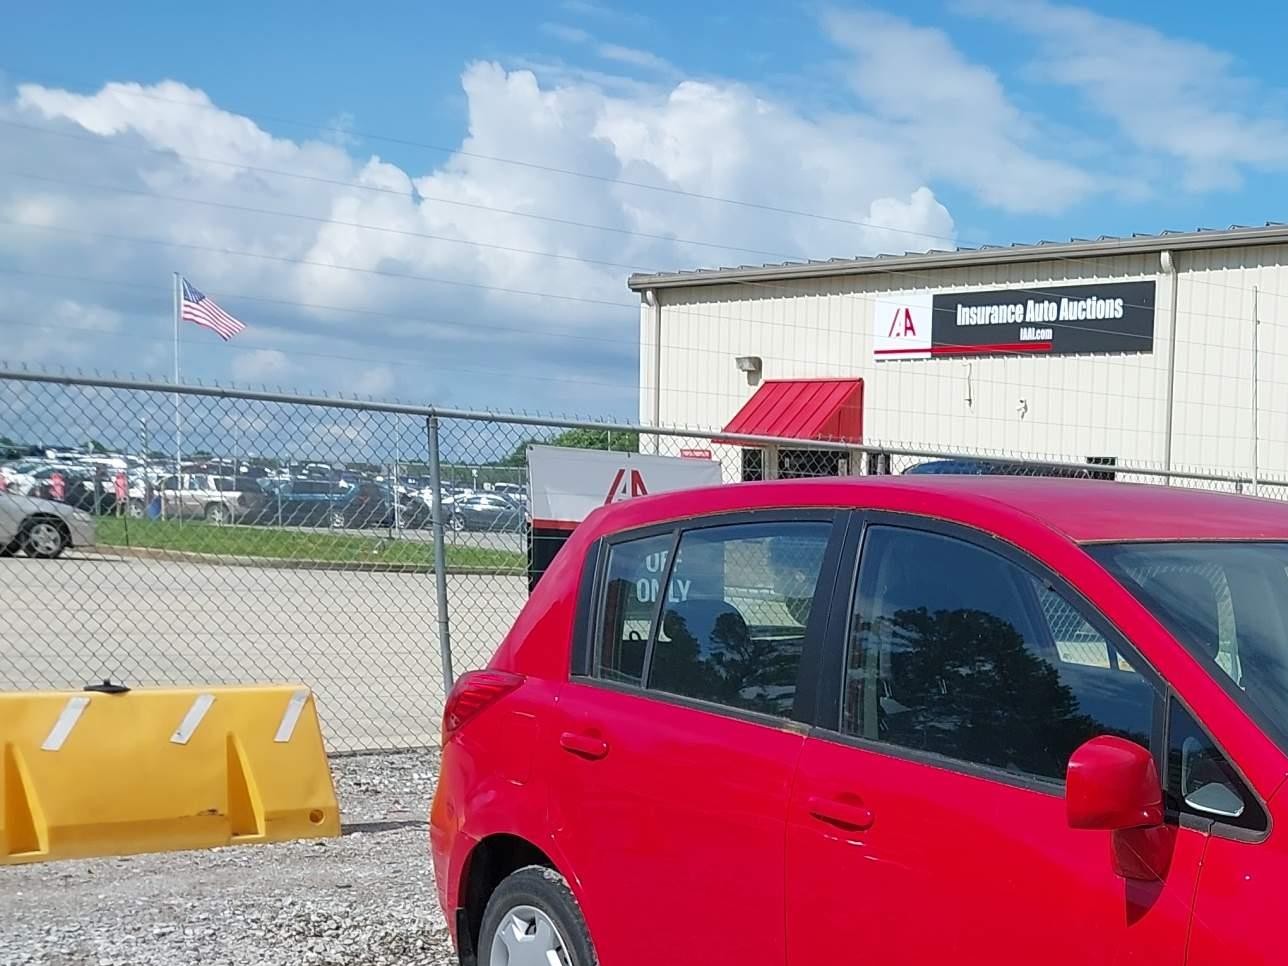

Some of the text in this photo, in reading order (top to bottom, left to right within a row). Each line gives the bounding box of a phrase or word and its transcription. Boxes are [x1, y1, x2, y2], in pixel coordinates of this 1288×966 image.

[956, 297, 1123, 326] Insurance Auto Auctions
[1019, 327, 1053, 341] IAAI.com
[636, 578, 691, 603] ONLY
